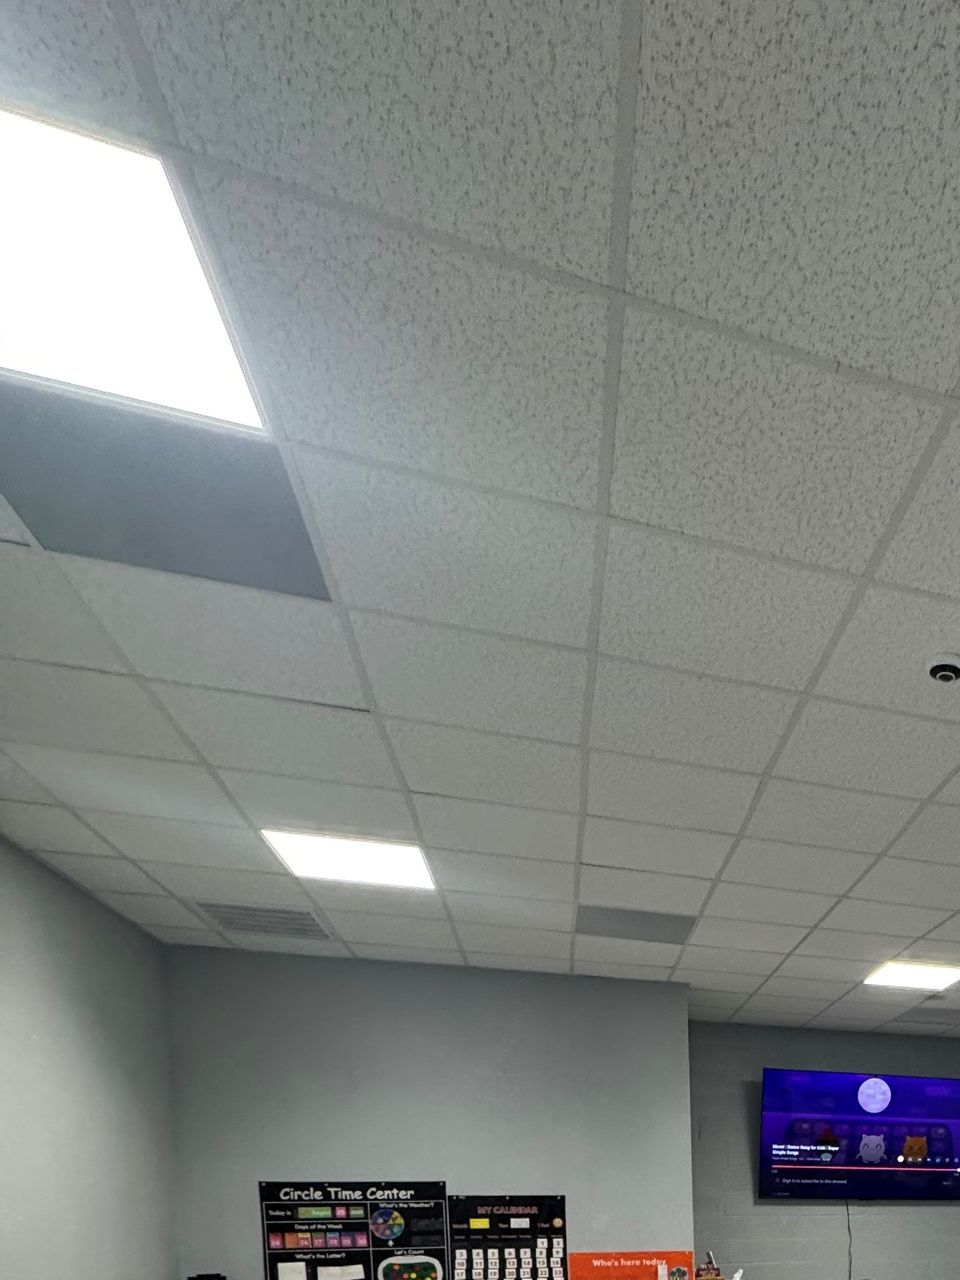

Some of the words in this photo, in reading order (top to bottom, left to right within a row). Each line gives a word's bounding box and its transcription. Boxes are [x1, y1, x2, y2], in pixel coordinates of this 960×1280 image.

[279, 1187, 323, 1200] Circle
[326, 1187, 363, 1200] Time
[366, 1187, 415, 1200] Center
[493, 1206, 539, 1214] CALENDAR
[592, 1258, 619, 1267] Who's
[620, 1258, 640, 1267] here
[643, 1257, 667, 1266] today
